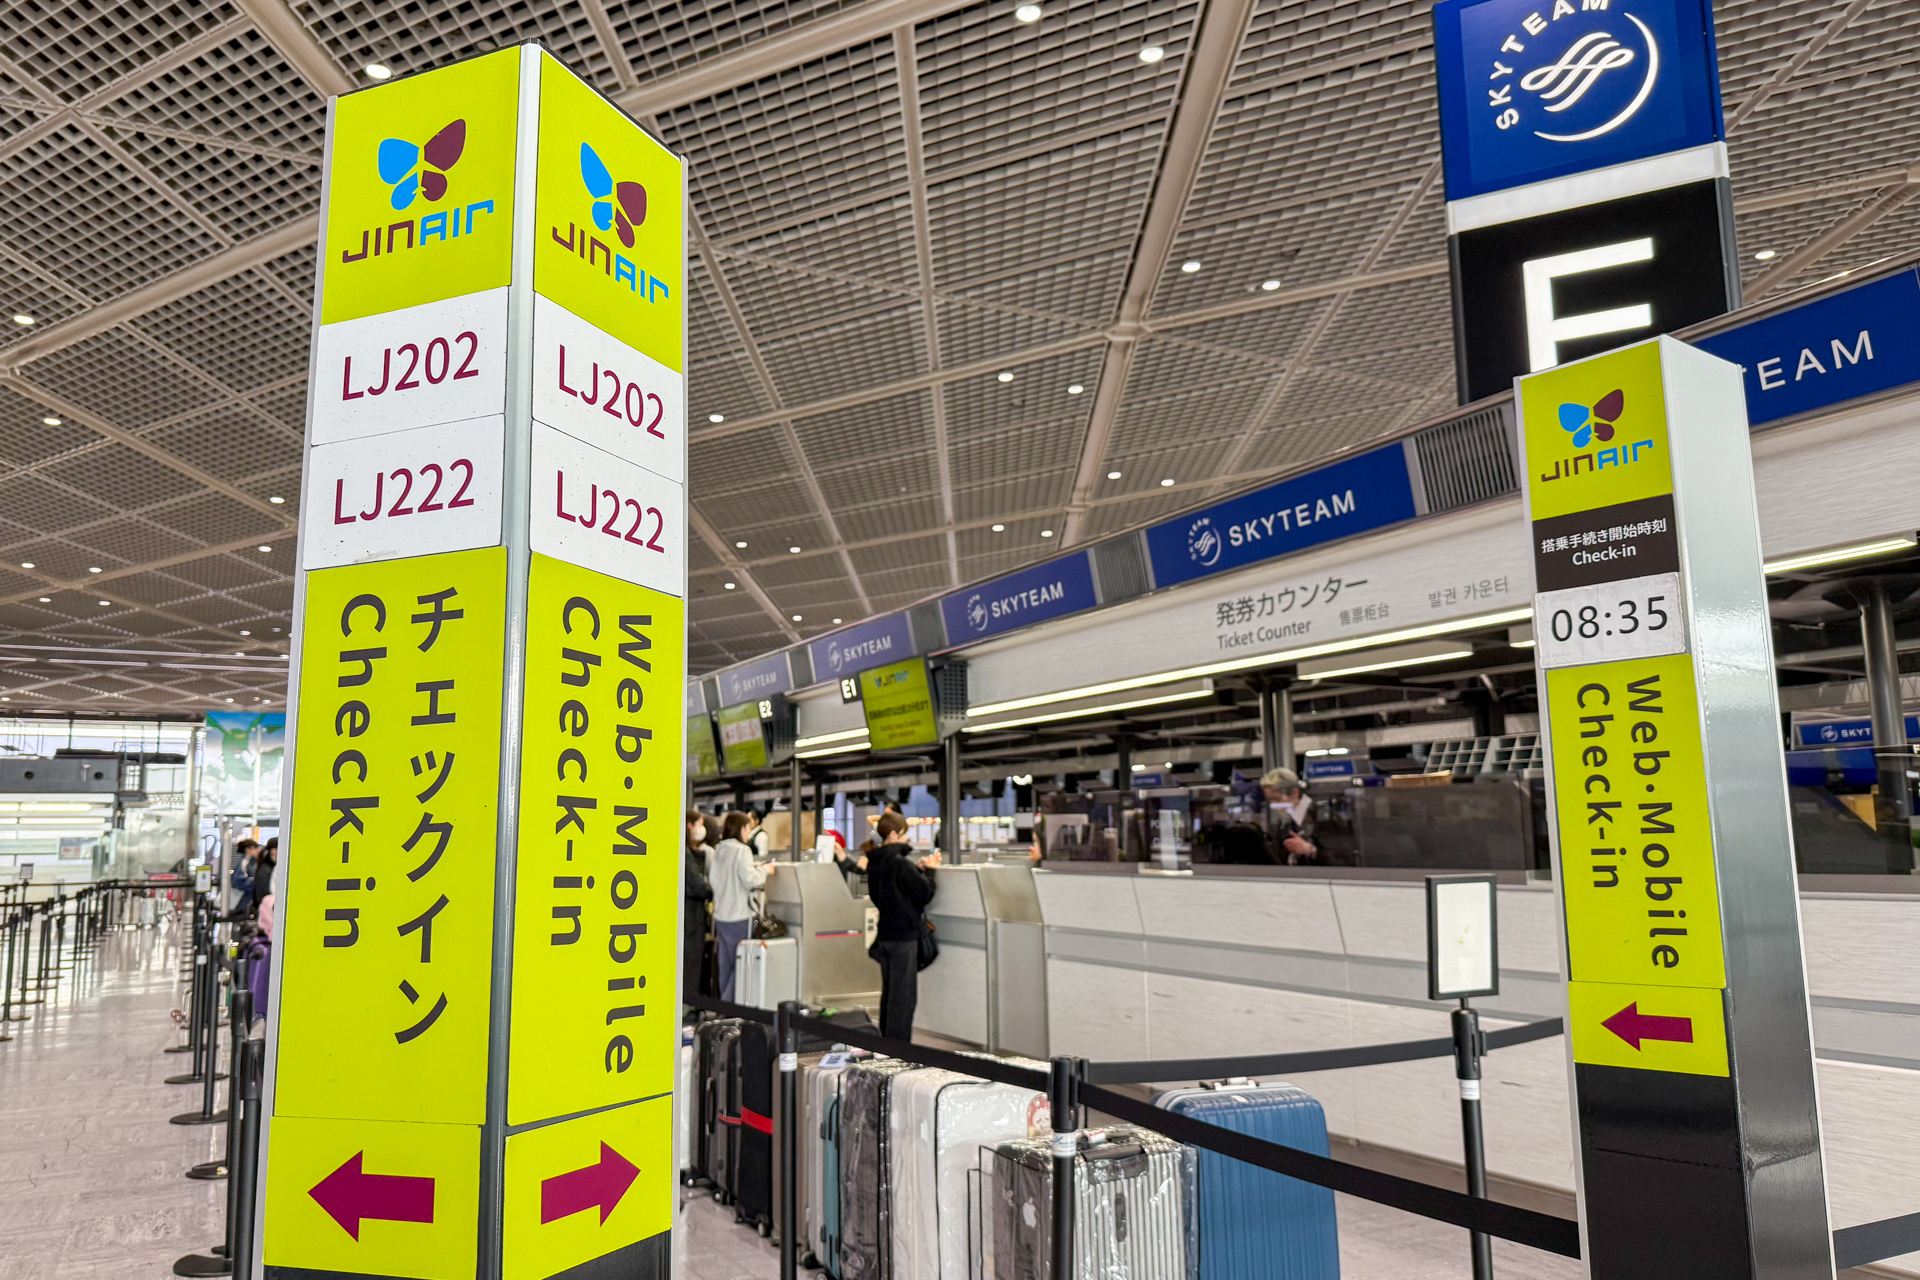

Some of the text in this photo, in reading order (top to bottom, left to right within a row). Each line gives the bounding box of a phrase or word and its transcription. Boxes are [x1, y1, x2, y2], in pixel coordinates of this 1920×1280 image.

[1488, 0, 1609, 130] SKYTEAM
[342, 331, 479, 401] LJ202
[559, 344, 665, 440] LJ202
[334, 458, 475, 525] LJ222
[556, 469, 665, 554] LJ222
[1228, 489, 1356, 547] SKYTEAM
[1541, 518, 1667, 554] 搭乗手続き開始時刻
[1572, 544, 1637, 566] Check-in
[991, 581, 1064, 618] SKYTEAM
[1216, 577, 1368, 627] 発券カウンター
[1428, 576, 1508, 609] 발권 카운터
[1217, 619, 1311, 650] Ticket Counter
[1551, 595, 1668, 642] 08:35
[843, 635, 892, 662] SKYTEAM
[742, 671, 777, 693] SKYTEAM
[841, 678, 857, 699] E1
[758, 700, 773, 719] E2
[322, 593, 388, 949] Check-in
[550, 596, 602, 946] Check-in
[1576, 683, 1627, 888] Check-in
[395, 586, 465, 1045] チェックイン
